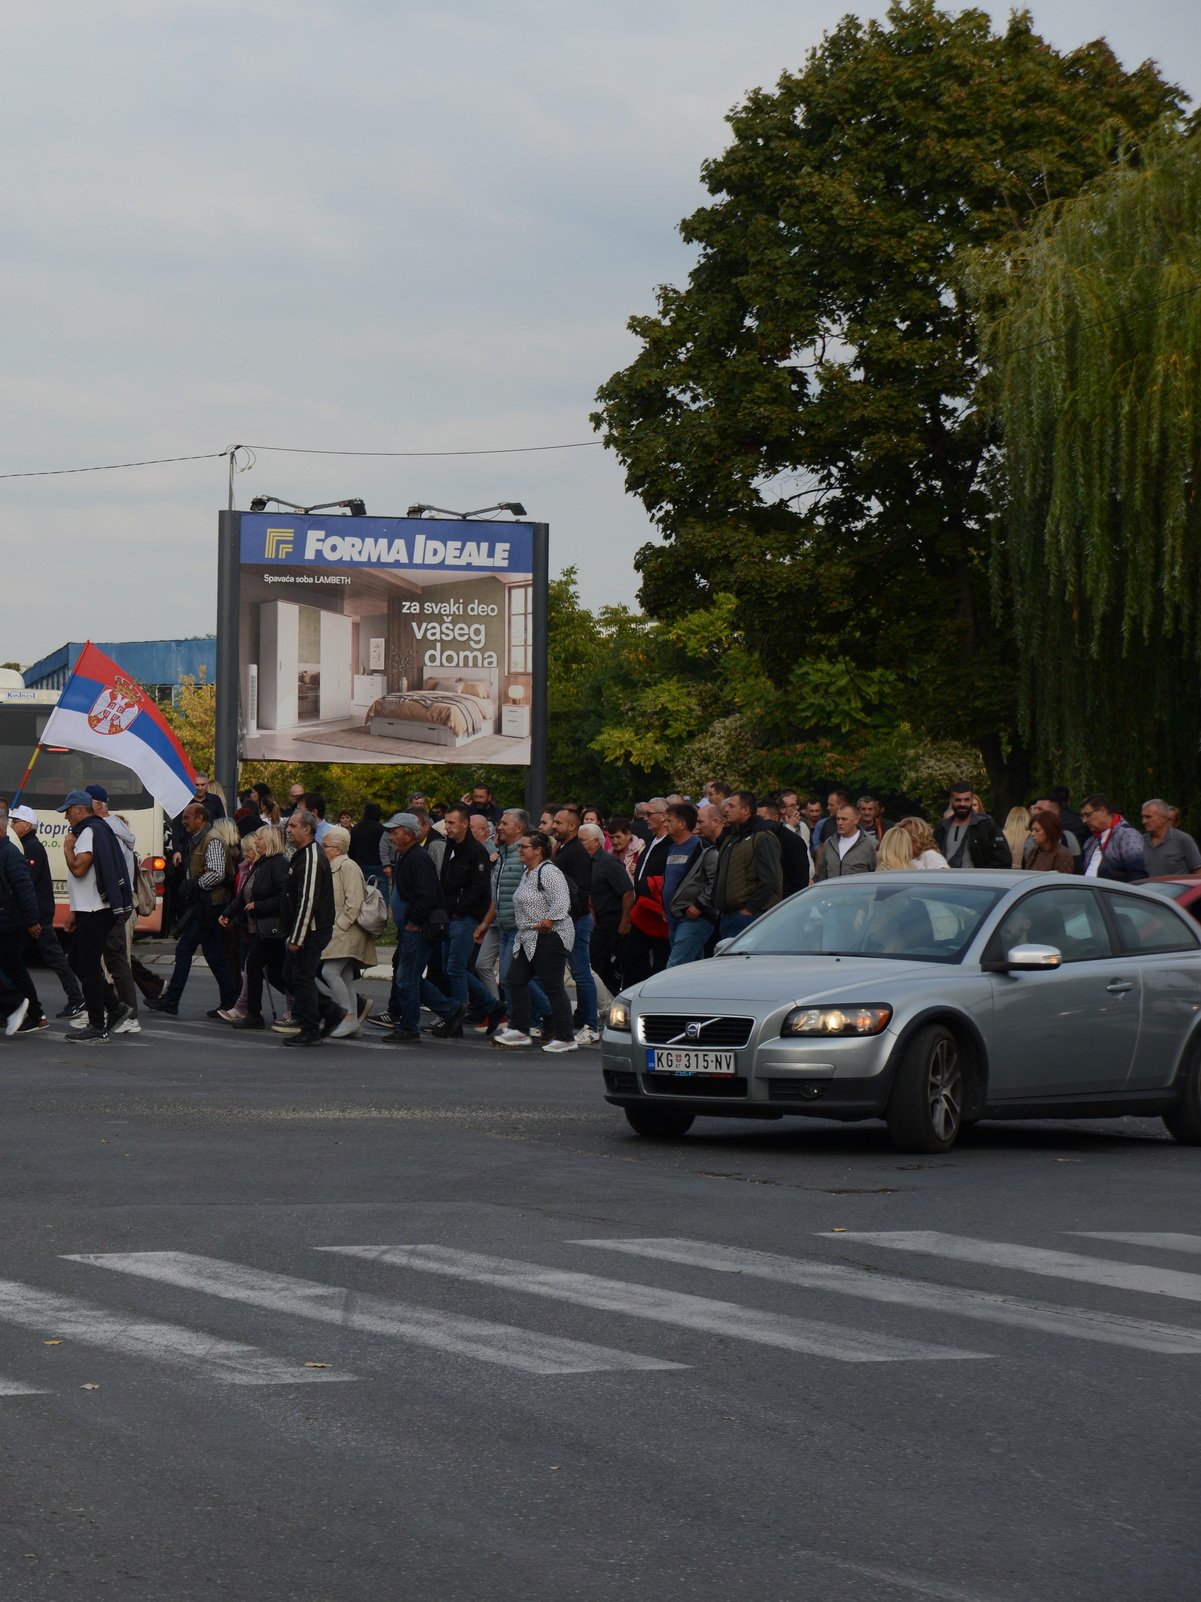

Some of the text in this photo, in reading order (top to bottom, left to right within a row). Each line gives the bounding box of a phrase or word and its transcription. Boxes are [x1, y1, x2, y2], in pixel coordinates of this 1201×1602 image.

[304, 530, 510, 567] FORMA IDEALE
[263, 573, 351, 585] Spavaća soba LAMBETH
[401, 598, 498, 616] za svaki deo
[411, 616, 486, 649] vašeg
[424, 642, 498, 667] doma
[656, 1052, 673, 1068] KG
